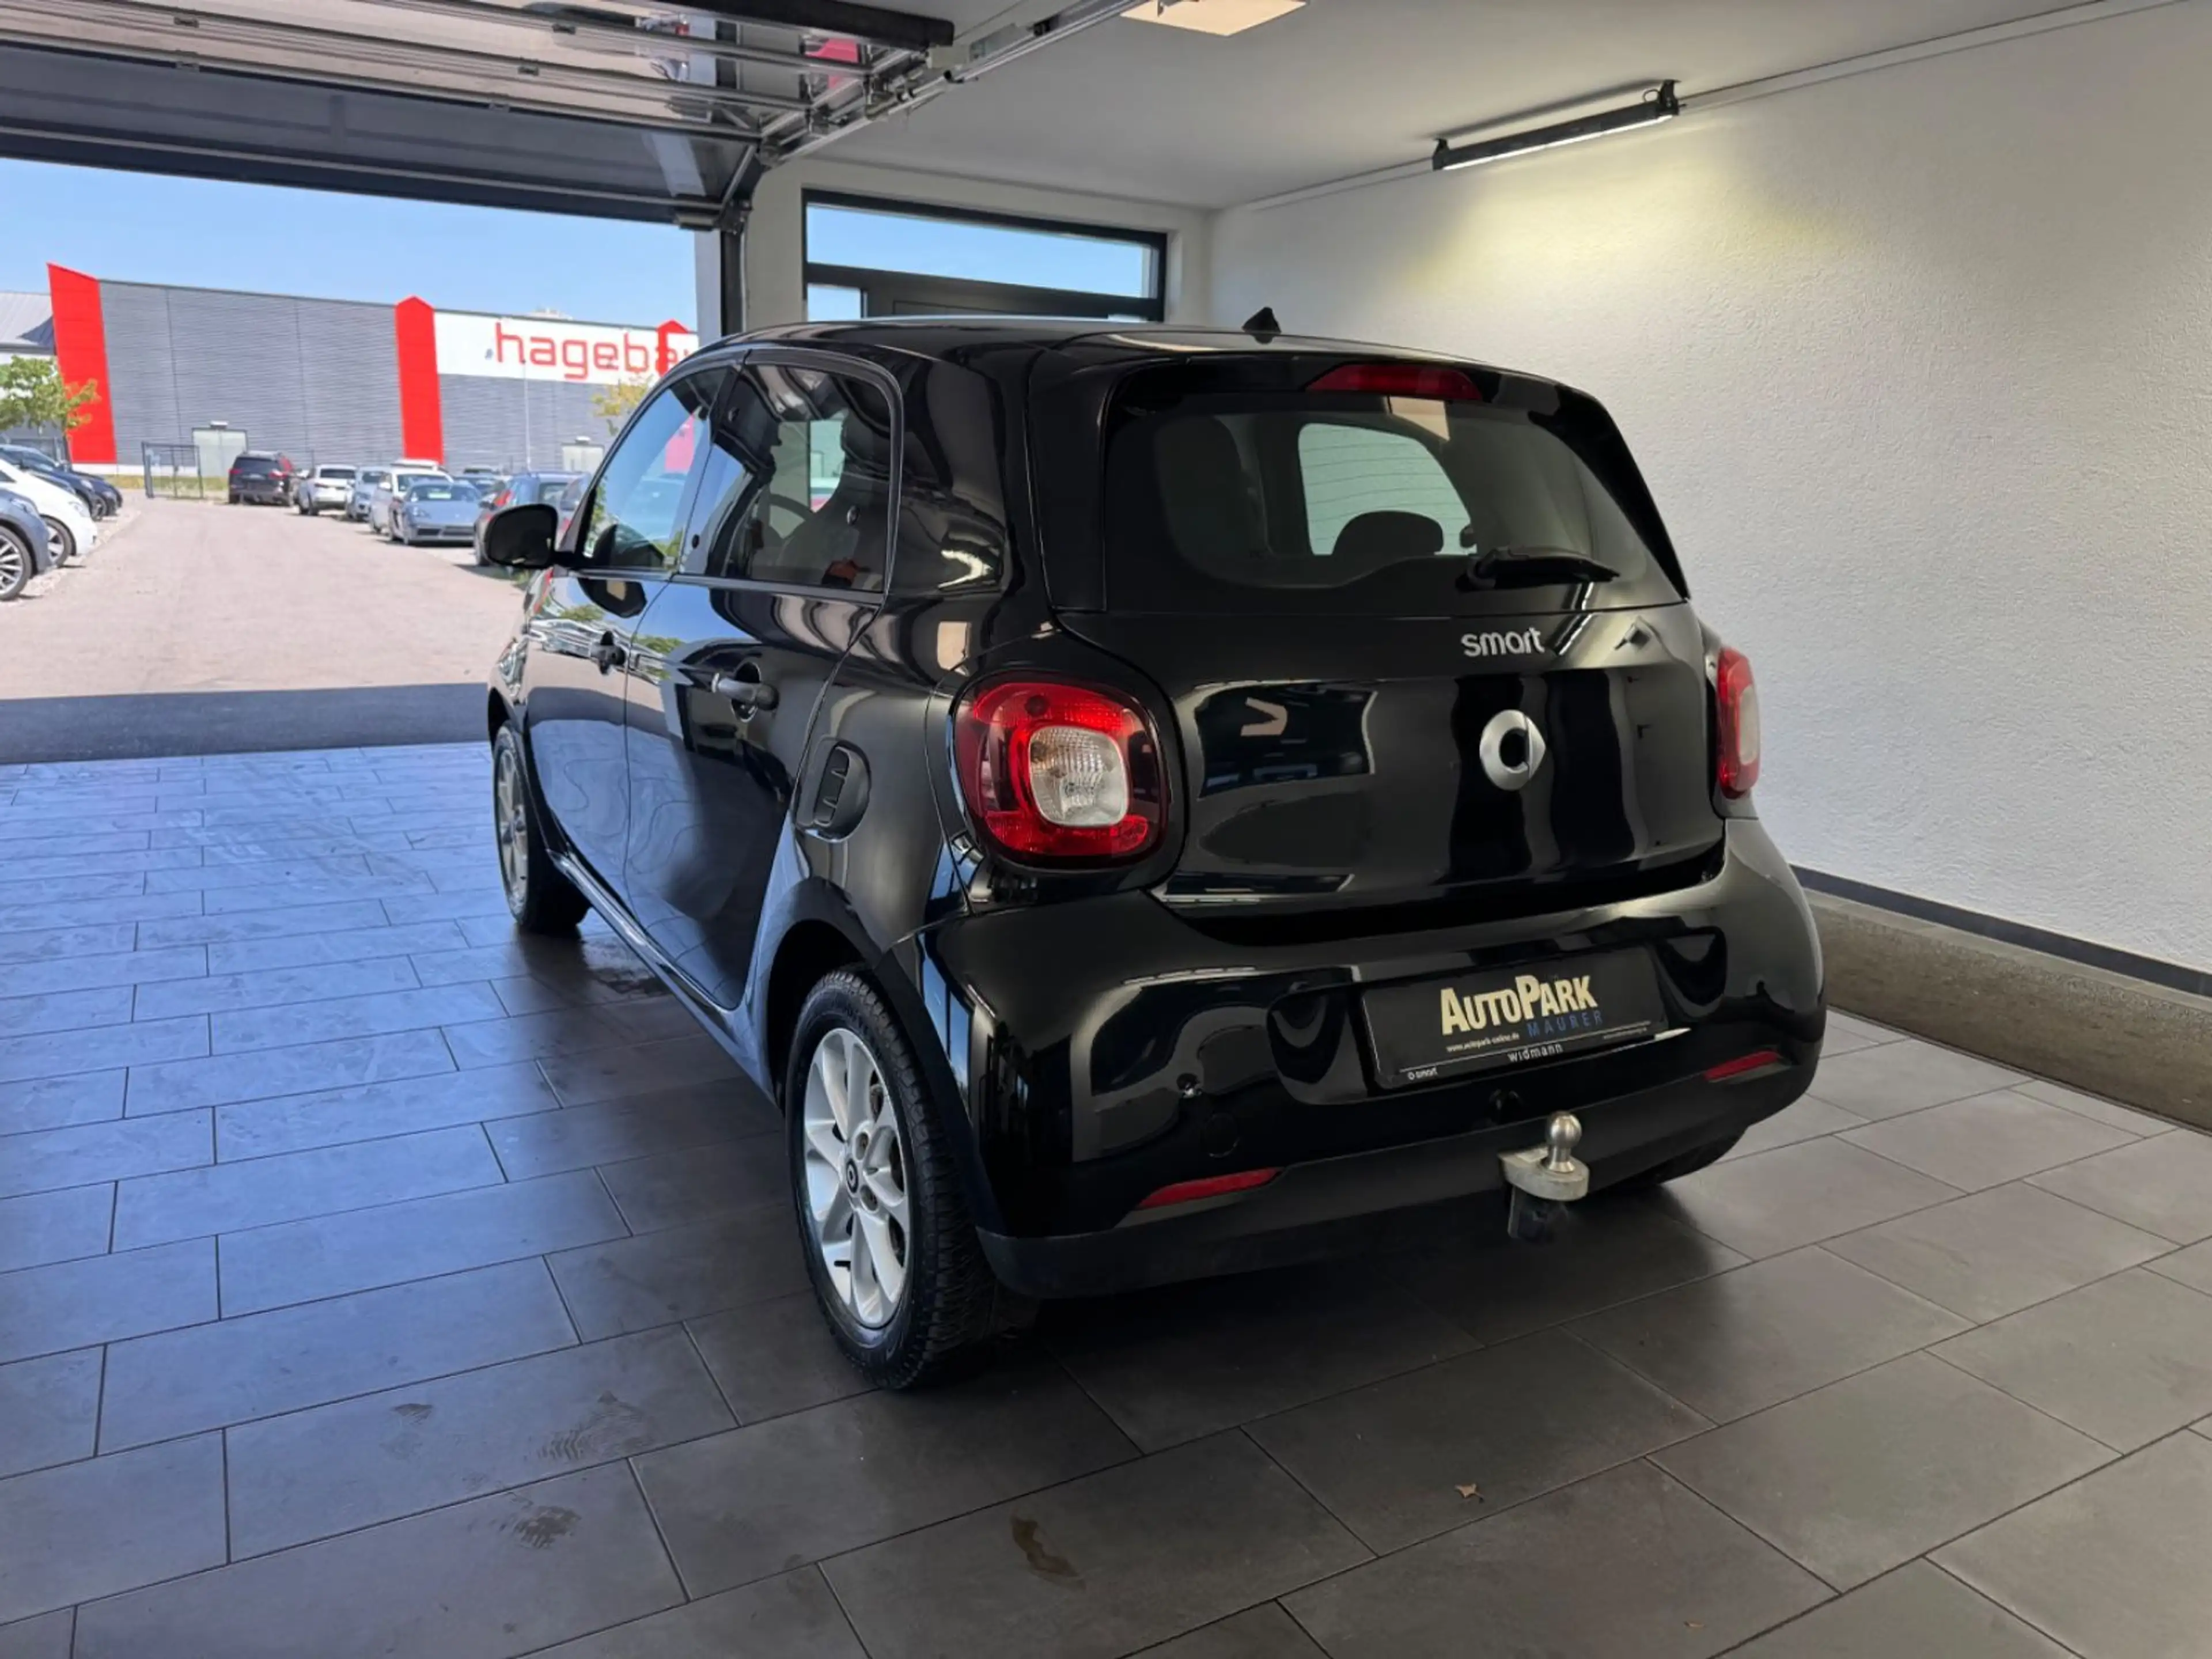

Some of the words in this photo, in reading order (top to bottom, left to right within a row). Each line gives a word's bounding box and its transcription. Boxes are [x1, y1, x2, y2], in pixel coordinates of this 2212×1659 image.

[1461, 627, 1545, 657] smart
[1527, 1010, 1603, 1038] MAURER
[1507, 1042, 1563, 1063] widmann
